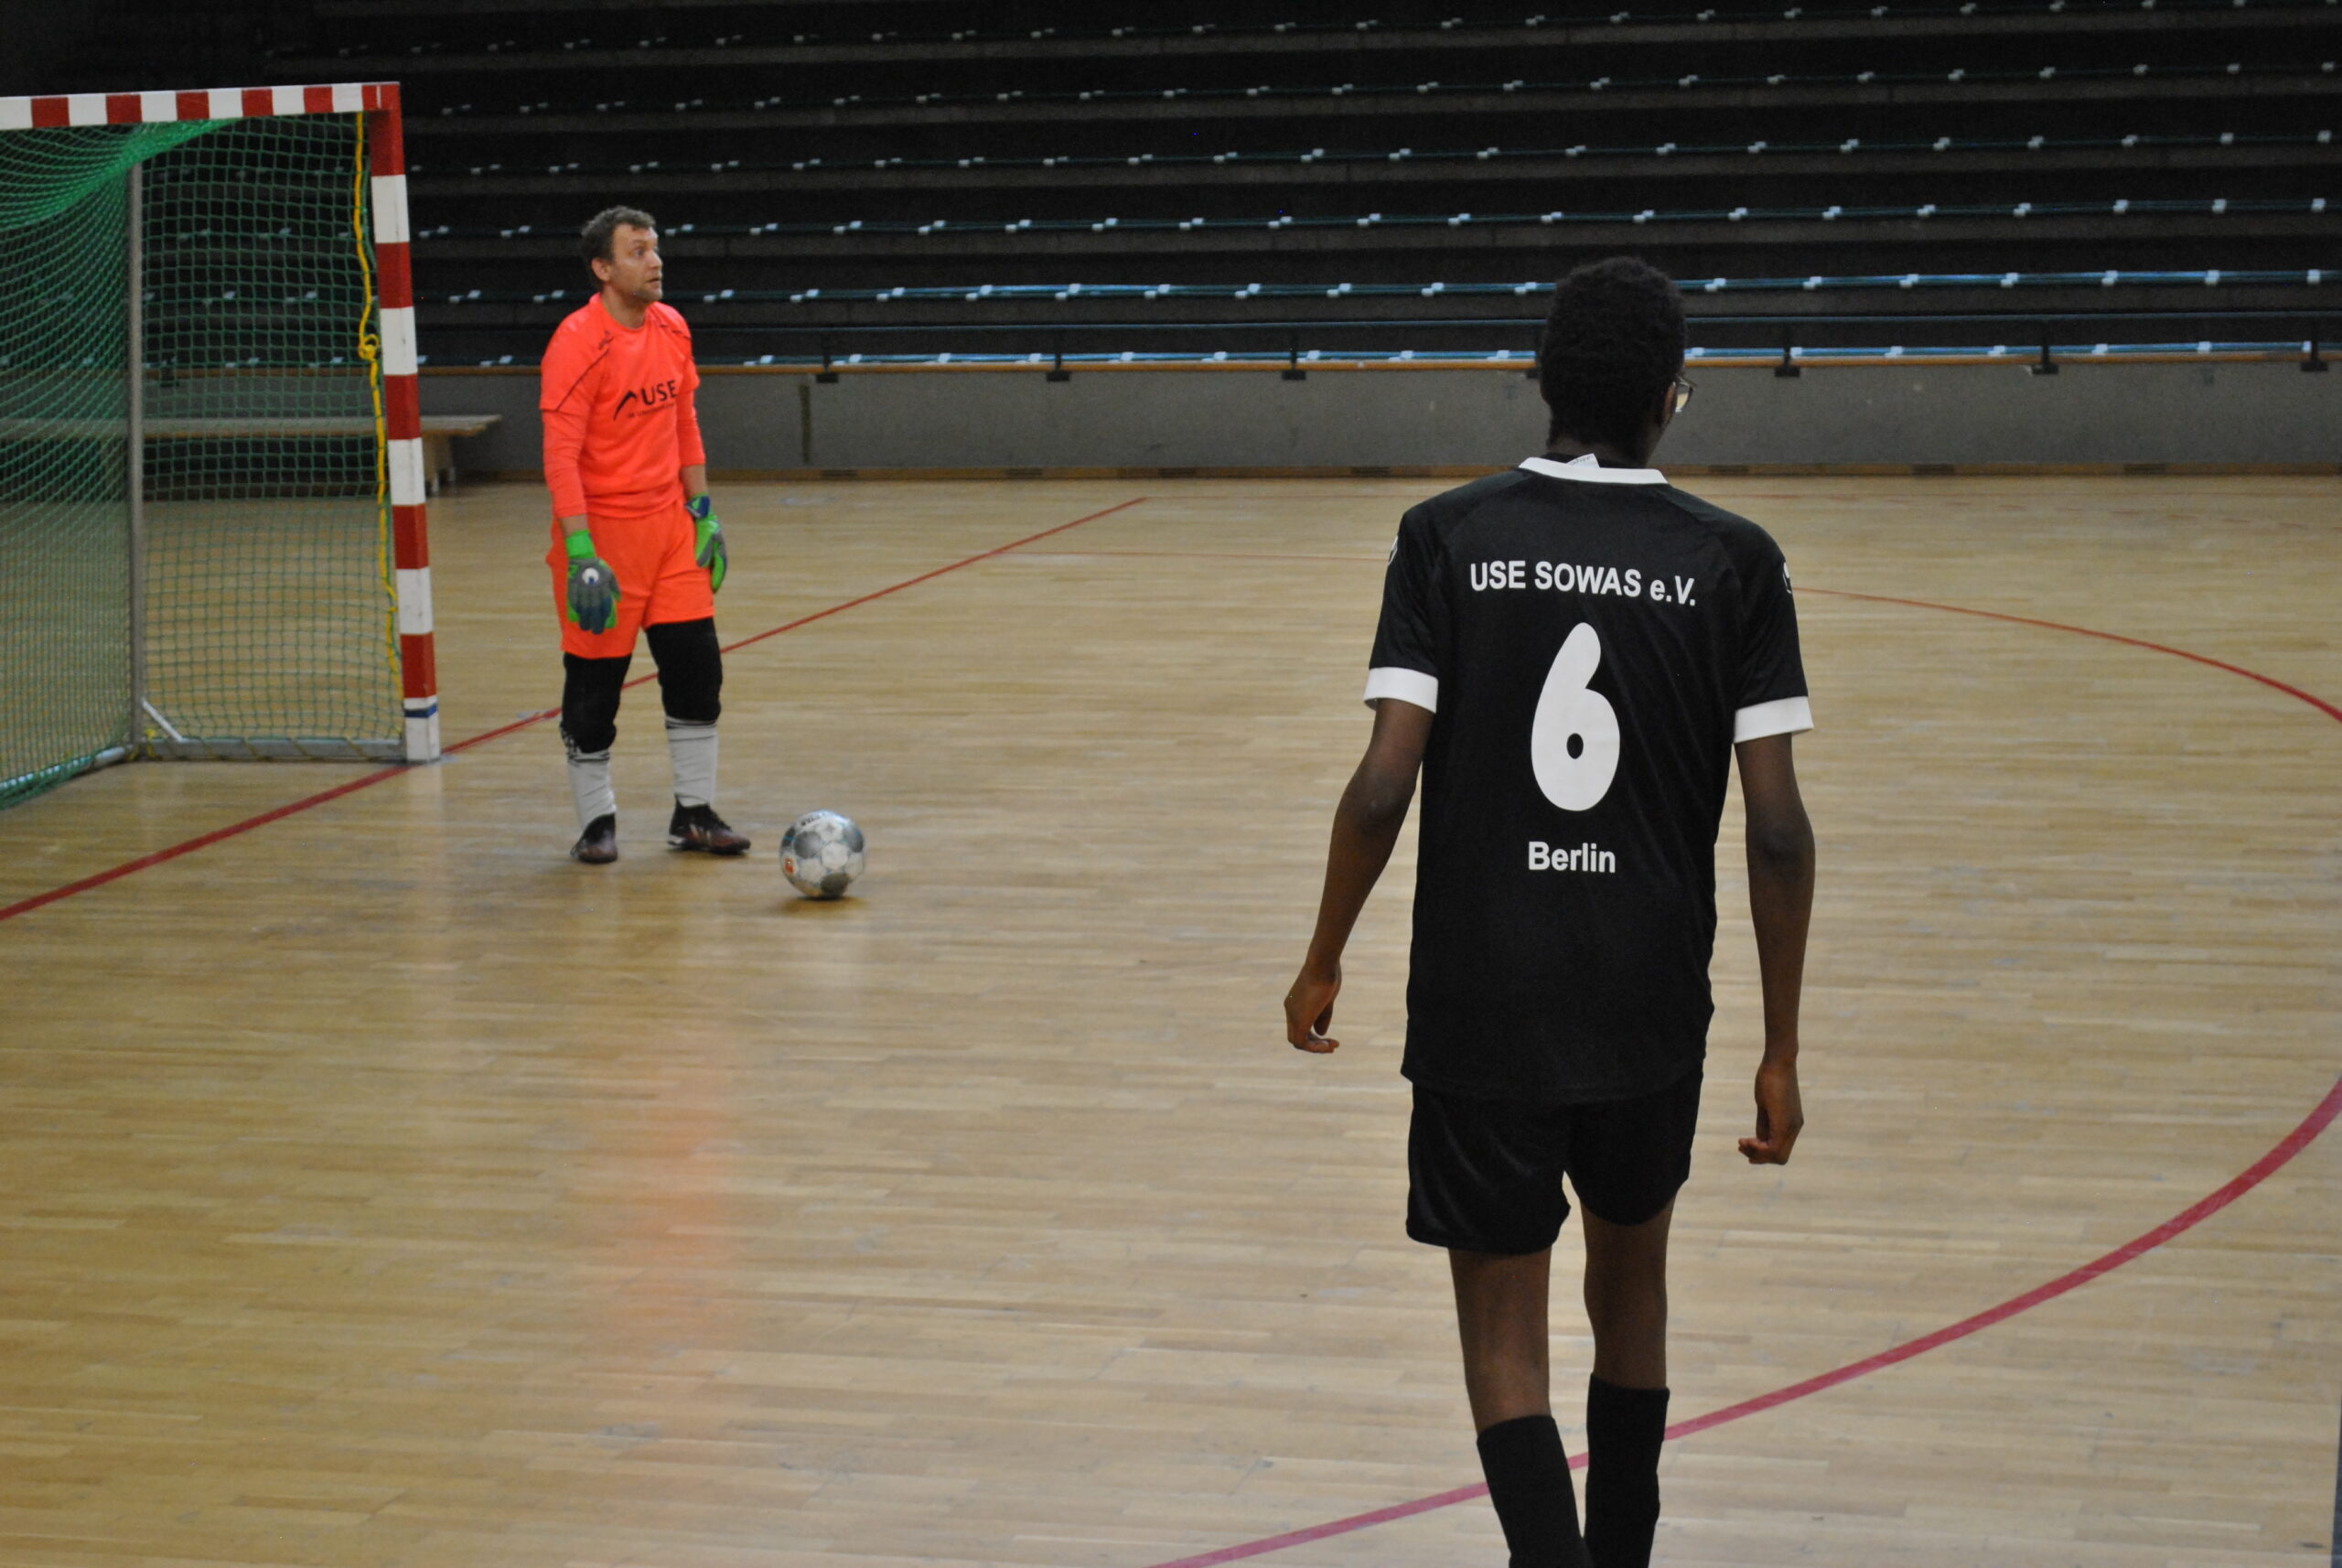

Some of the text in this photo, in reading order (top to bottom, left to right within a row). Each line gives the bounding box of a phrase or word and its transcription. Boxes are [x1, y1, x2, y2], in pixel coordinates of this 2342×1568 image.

[640, 379, 678, 405] USE
[1470, 560, 1696, 607] USE SOWAS e.V.
[1531, 622, 1621, 811] 6
[1528, 841, 1616, 874] Berlin
